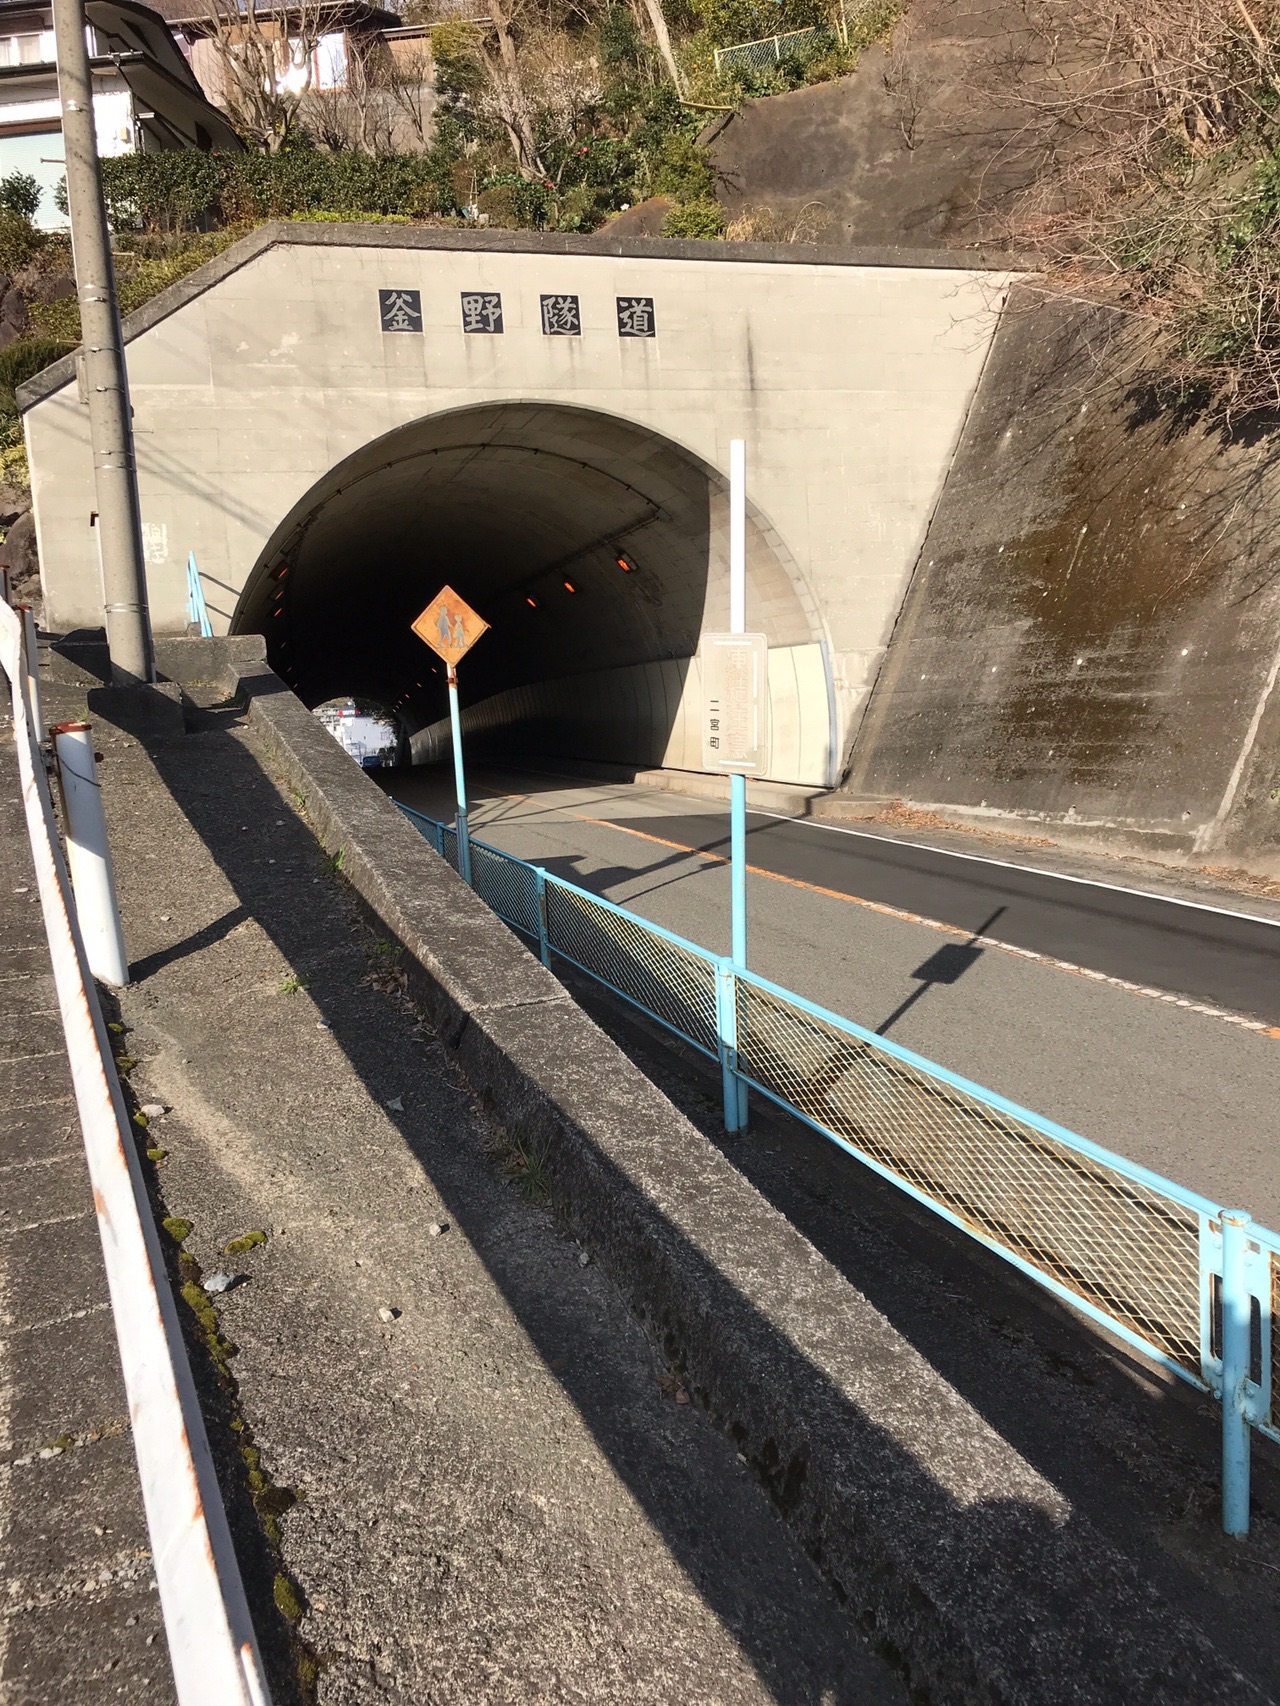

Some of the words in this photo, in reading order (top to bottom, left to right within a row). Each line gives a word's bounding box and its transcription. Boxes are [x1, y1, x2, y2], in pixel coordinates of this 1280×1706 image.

[382, 290, 654, 337] 釜野隧道
[709, 699, 720, 750] 二宮町
[724, 648, 749, 760] 凍結注意
